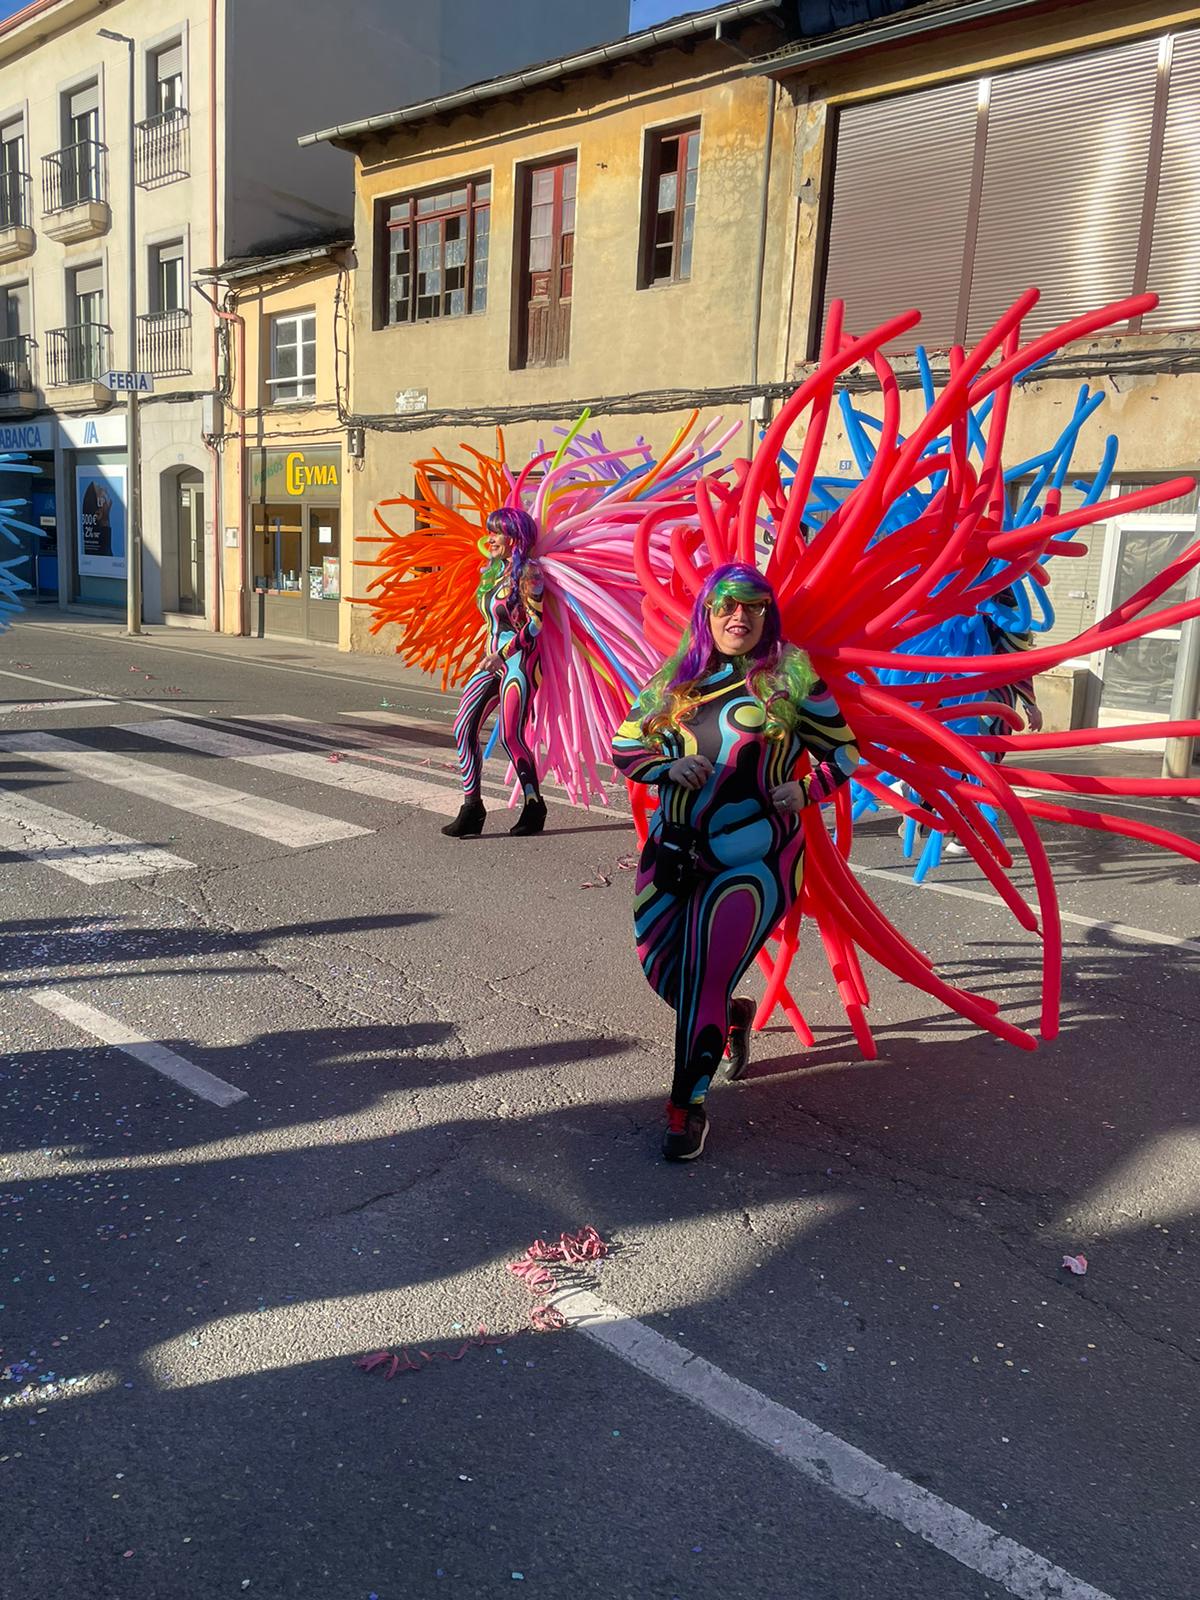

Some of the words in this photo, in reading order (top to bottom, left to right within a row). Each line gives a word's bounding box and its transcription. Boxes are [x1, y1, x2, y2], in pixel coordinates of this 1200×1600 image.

[109, 373, 148, 390] FERIA
[0, 426, 42, 449] ABANCA
[286, 452, 338, 496] CEYMA
[841, 461, 850, 469] 51
